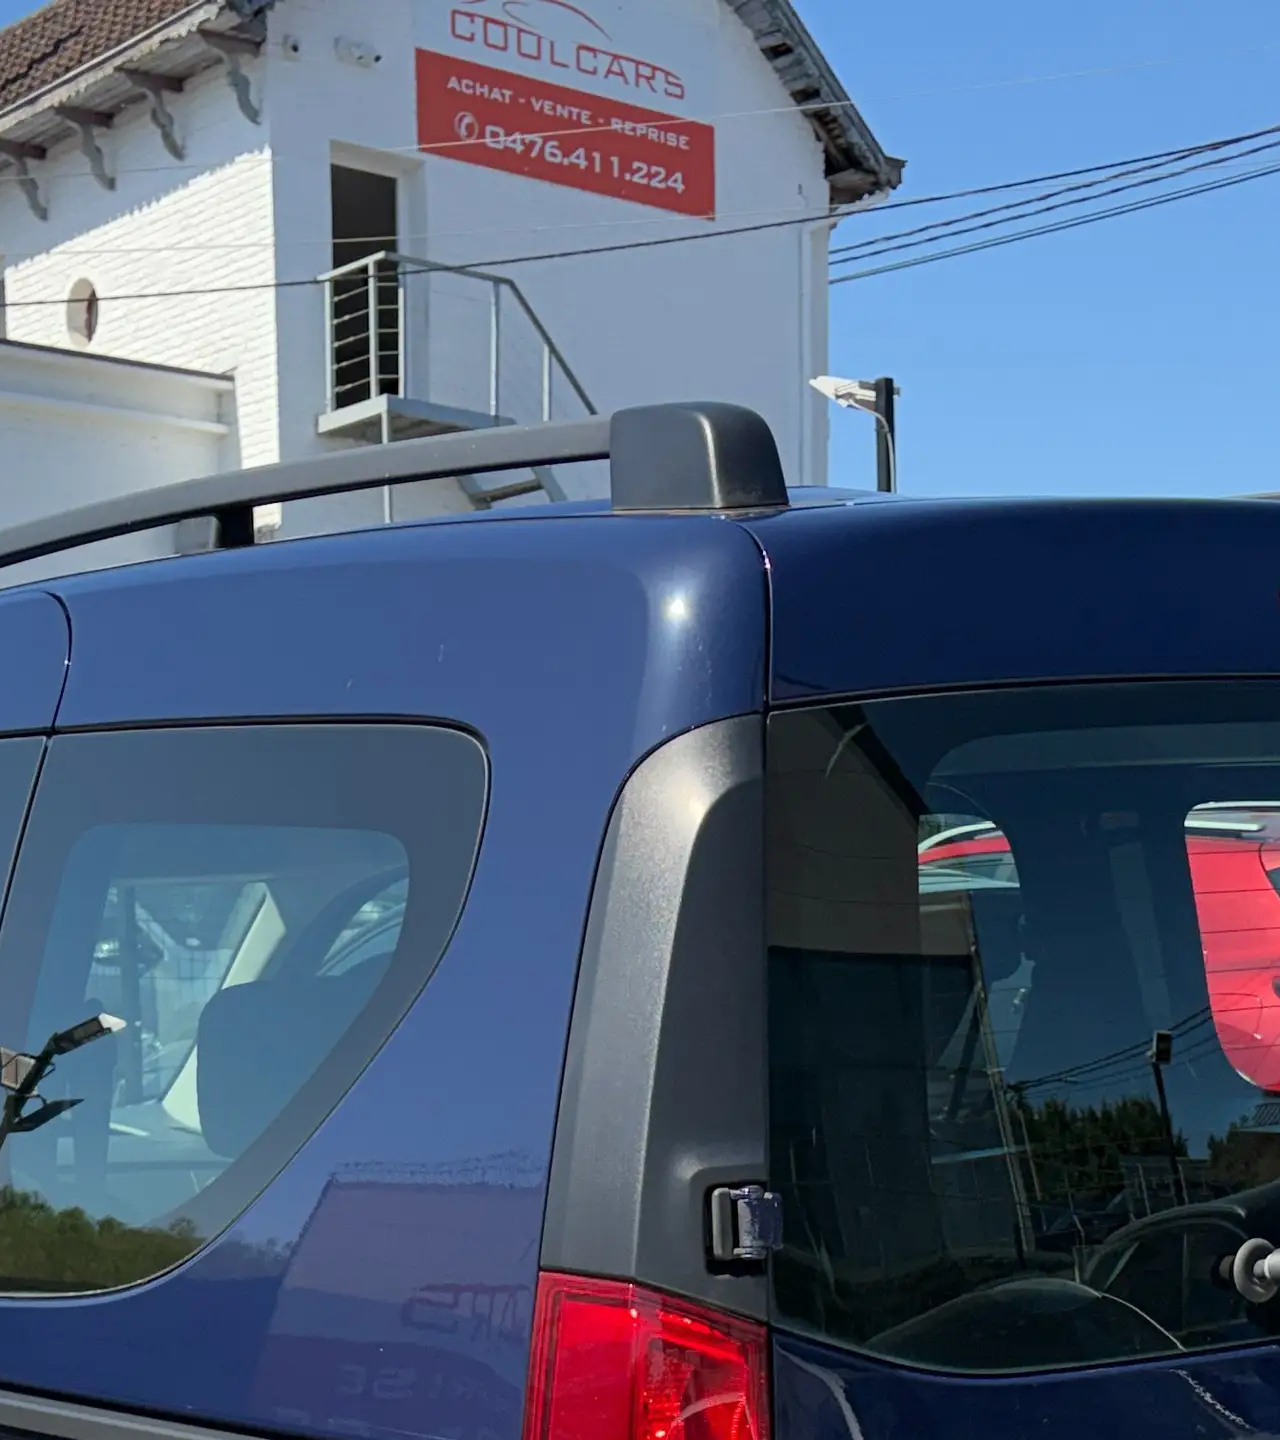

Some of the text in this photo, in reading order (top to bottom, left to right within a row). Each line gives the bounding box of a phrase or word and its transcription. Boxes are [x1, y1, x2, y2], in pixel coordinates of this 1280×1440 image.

[451, 9, 685, 100] COOLCARS
[447, 75, 513, 104] ACHAT
[530, 96, 592, 125] VENTE
[610, 117, 690, 150] REPRISE
[484, 125, 686, 194] 0476.411.224
